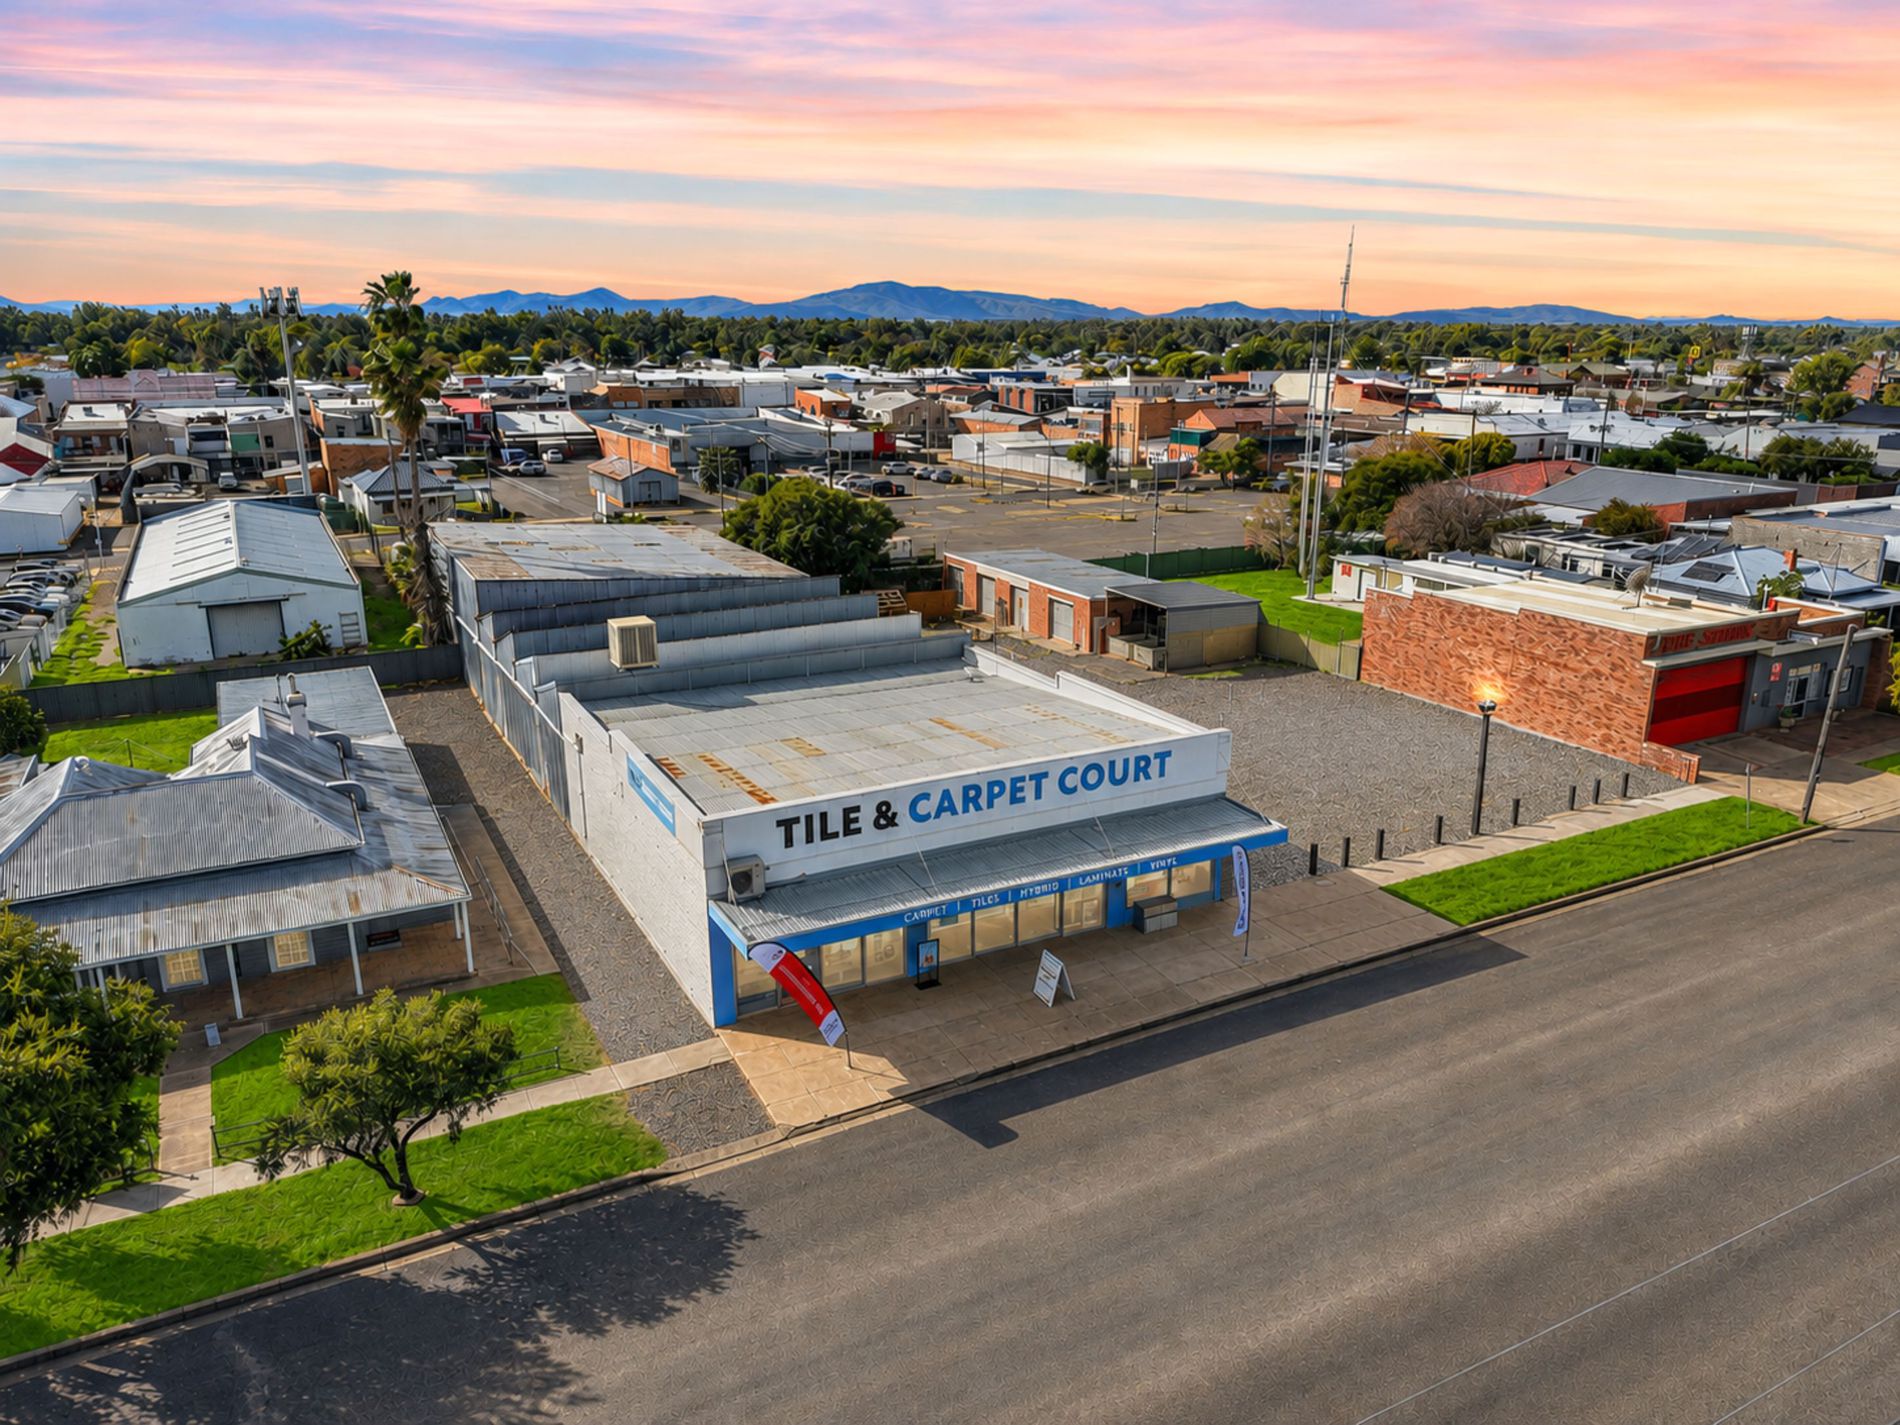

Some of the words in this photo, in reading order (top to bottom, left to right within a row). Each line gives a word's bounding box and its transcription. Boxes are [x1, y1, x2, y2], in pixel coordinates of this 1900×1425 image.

[776, 804, 862, 849] TILE
[873, 800, 899, 830] &
[908, 770, 1049, 823] CARPET
[1058, 750, 1172, 796] COURT
